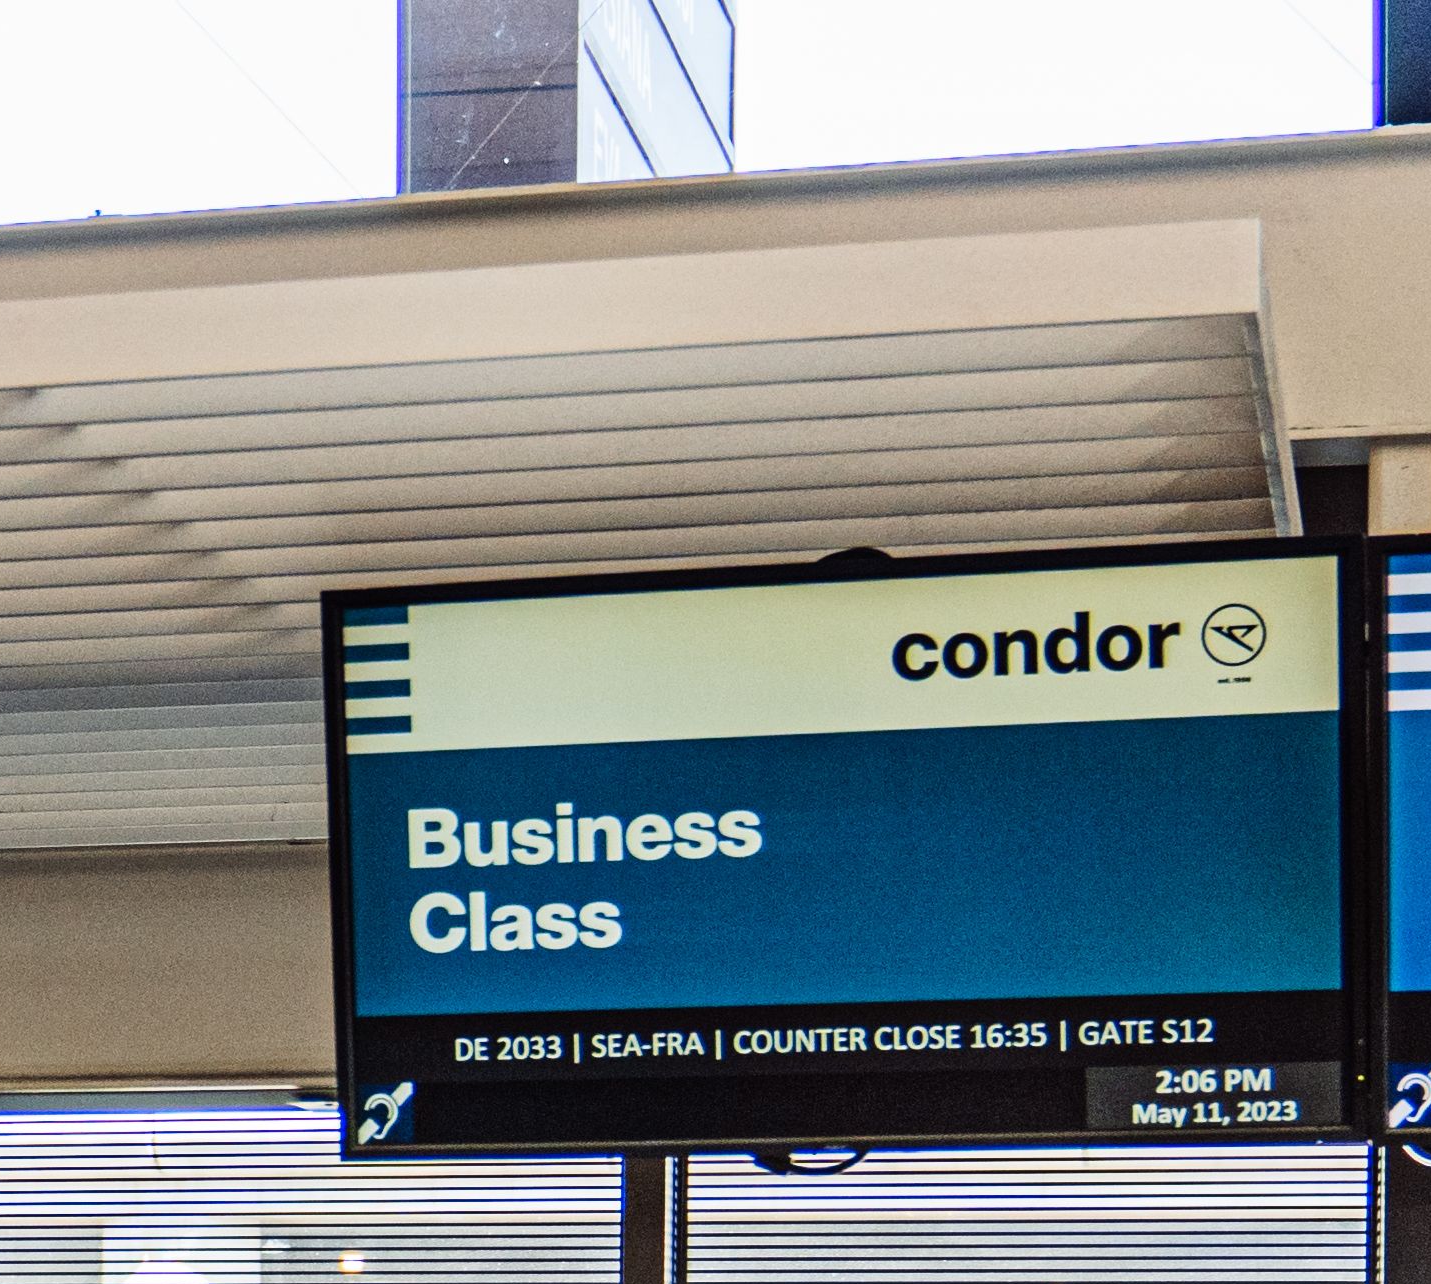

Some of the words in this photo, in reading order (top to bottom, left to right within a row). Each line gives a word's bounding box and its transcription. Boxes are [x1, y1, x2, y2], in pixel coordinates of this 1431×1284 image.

[892, 611, 1180, 681] condor
[408, 803, 762, 868] Business
[410, 891, 622, 953] Class
[454, 1037, 490, 1062] DE
[496, 1035, 563, 1061] 2033
[591, 1031, 705, 1059] SEA-FRA
[733, 1028, 867, 1055] COUNTER
[873, 1025, 962, 1051] CLOSE
[971, 1022, 1048, 1049] 16:35
[1078, 1019, 1154, 1046] GATE
[1161, 1017, 1214, 1044] S12
[1155, 1068, 1218, 1094] 2:06
[1224, 1067, 1272, 1093] PM
[1132, 1103, 1188, 1128] May
[1192, 1101, 1231, 1127] 11,
[1236, 1100, 1298, 1123] 2023
